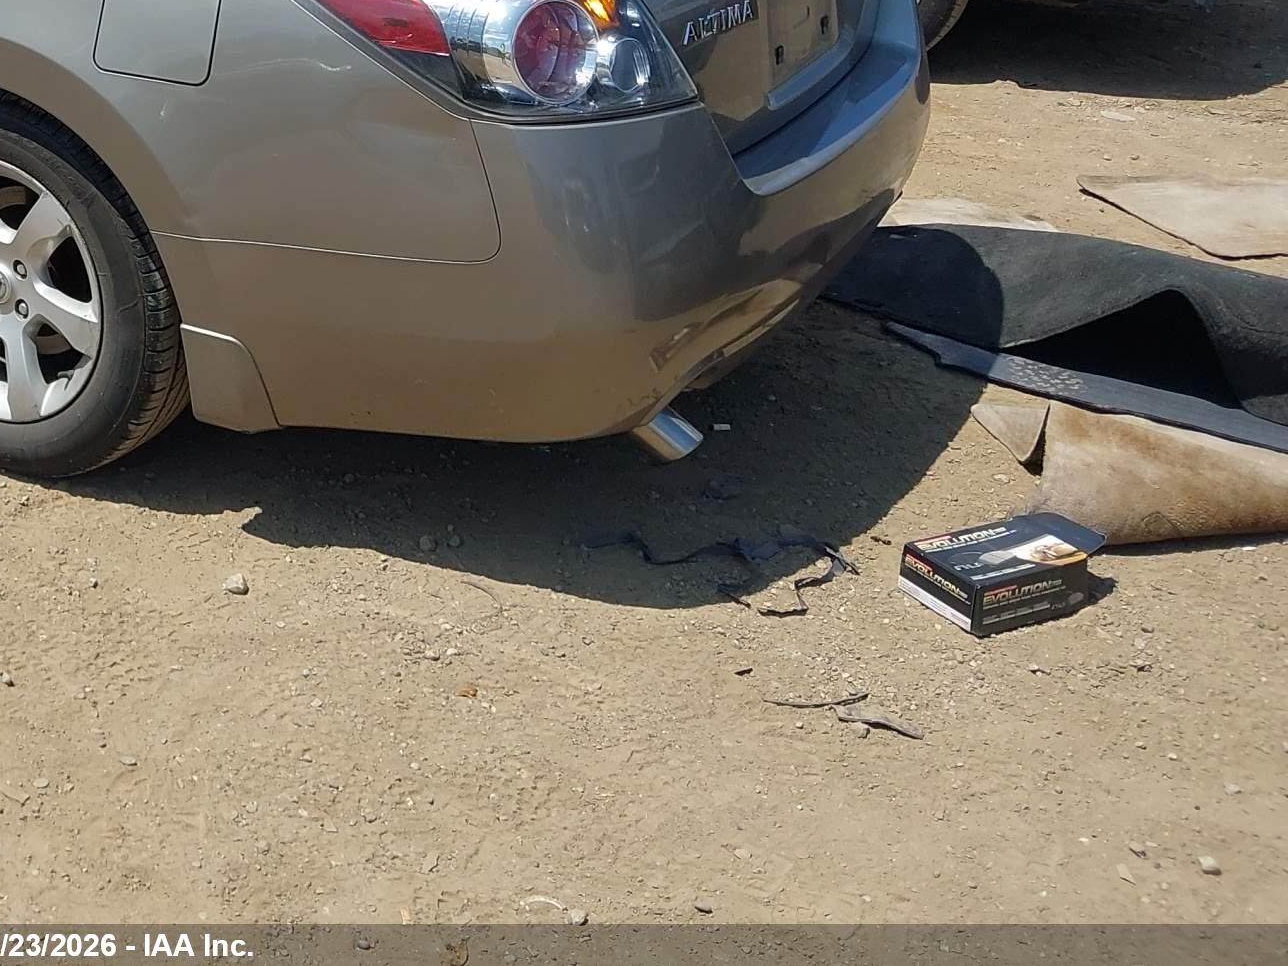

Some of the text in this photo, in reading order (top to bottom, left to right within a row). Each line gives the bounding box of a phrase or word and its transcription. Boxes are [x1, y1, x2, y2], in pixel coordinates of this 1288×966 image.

[683, 0, 753, 45] ALTIMA
[917, 529, 993, 552] EVOLUTION
[905, 556, 960, 594] EVOLUTION
[983, 581, 1051, 605] EVOLUTION
